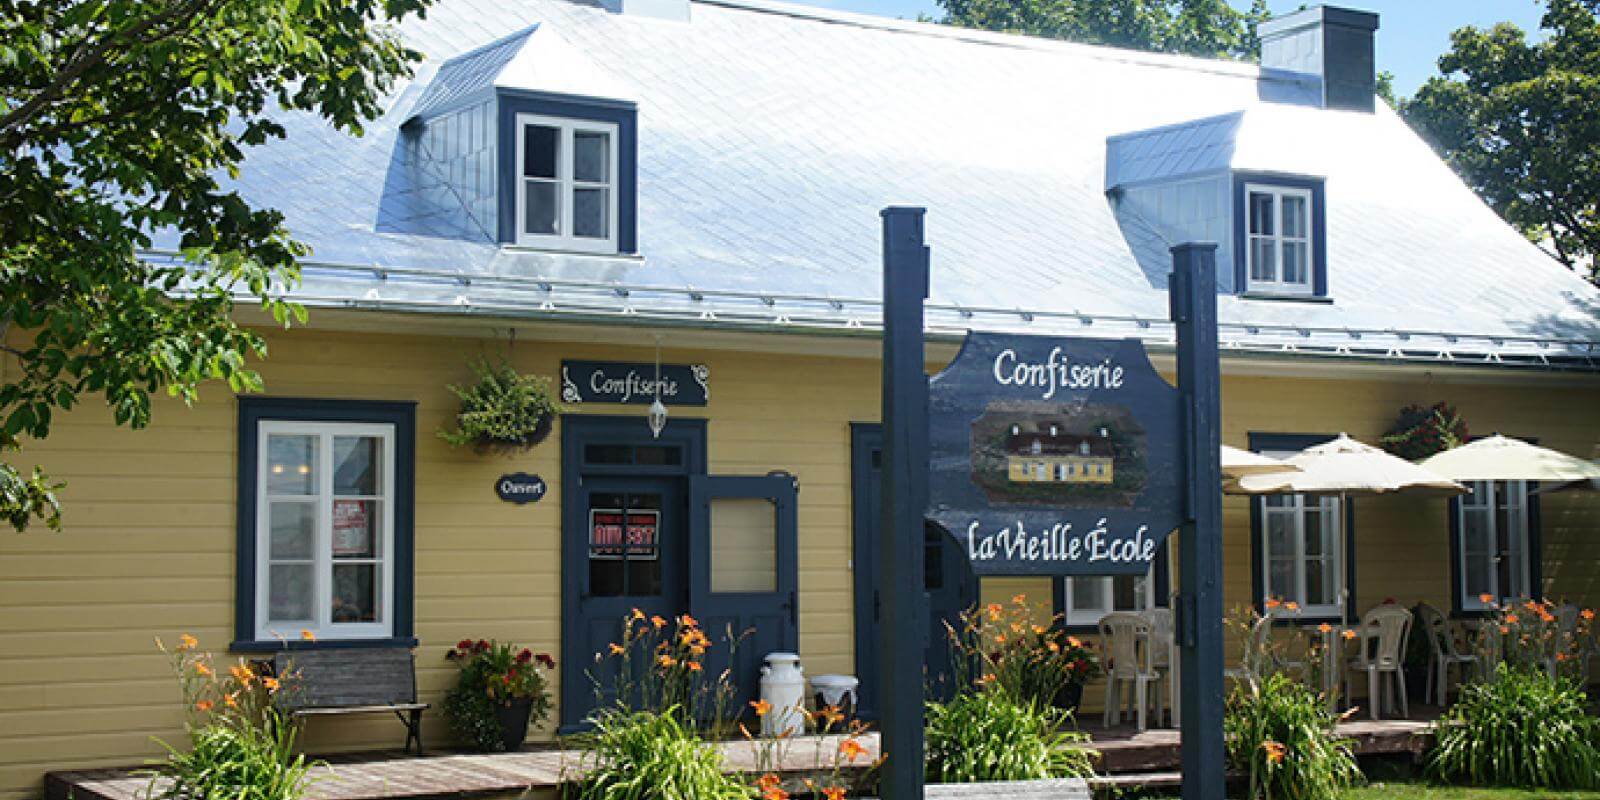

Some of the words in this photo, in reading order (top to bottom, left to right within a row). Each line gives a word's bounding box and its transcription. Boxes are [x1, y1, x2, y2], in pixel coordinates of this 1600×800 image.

[591, 369, 678, 402] Confiserie
[994, 347, 1124, 399] Confiserie
[500, 480, 542, 494] Ouvert
[997, 520, 1081, 561] Vieille
[1085, 517, 1156, 561] École
